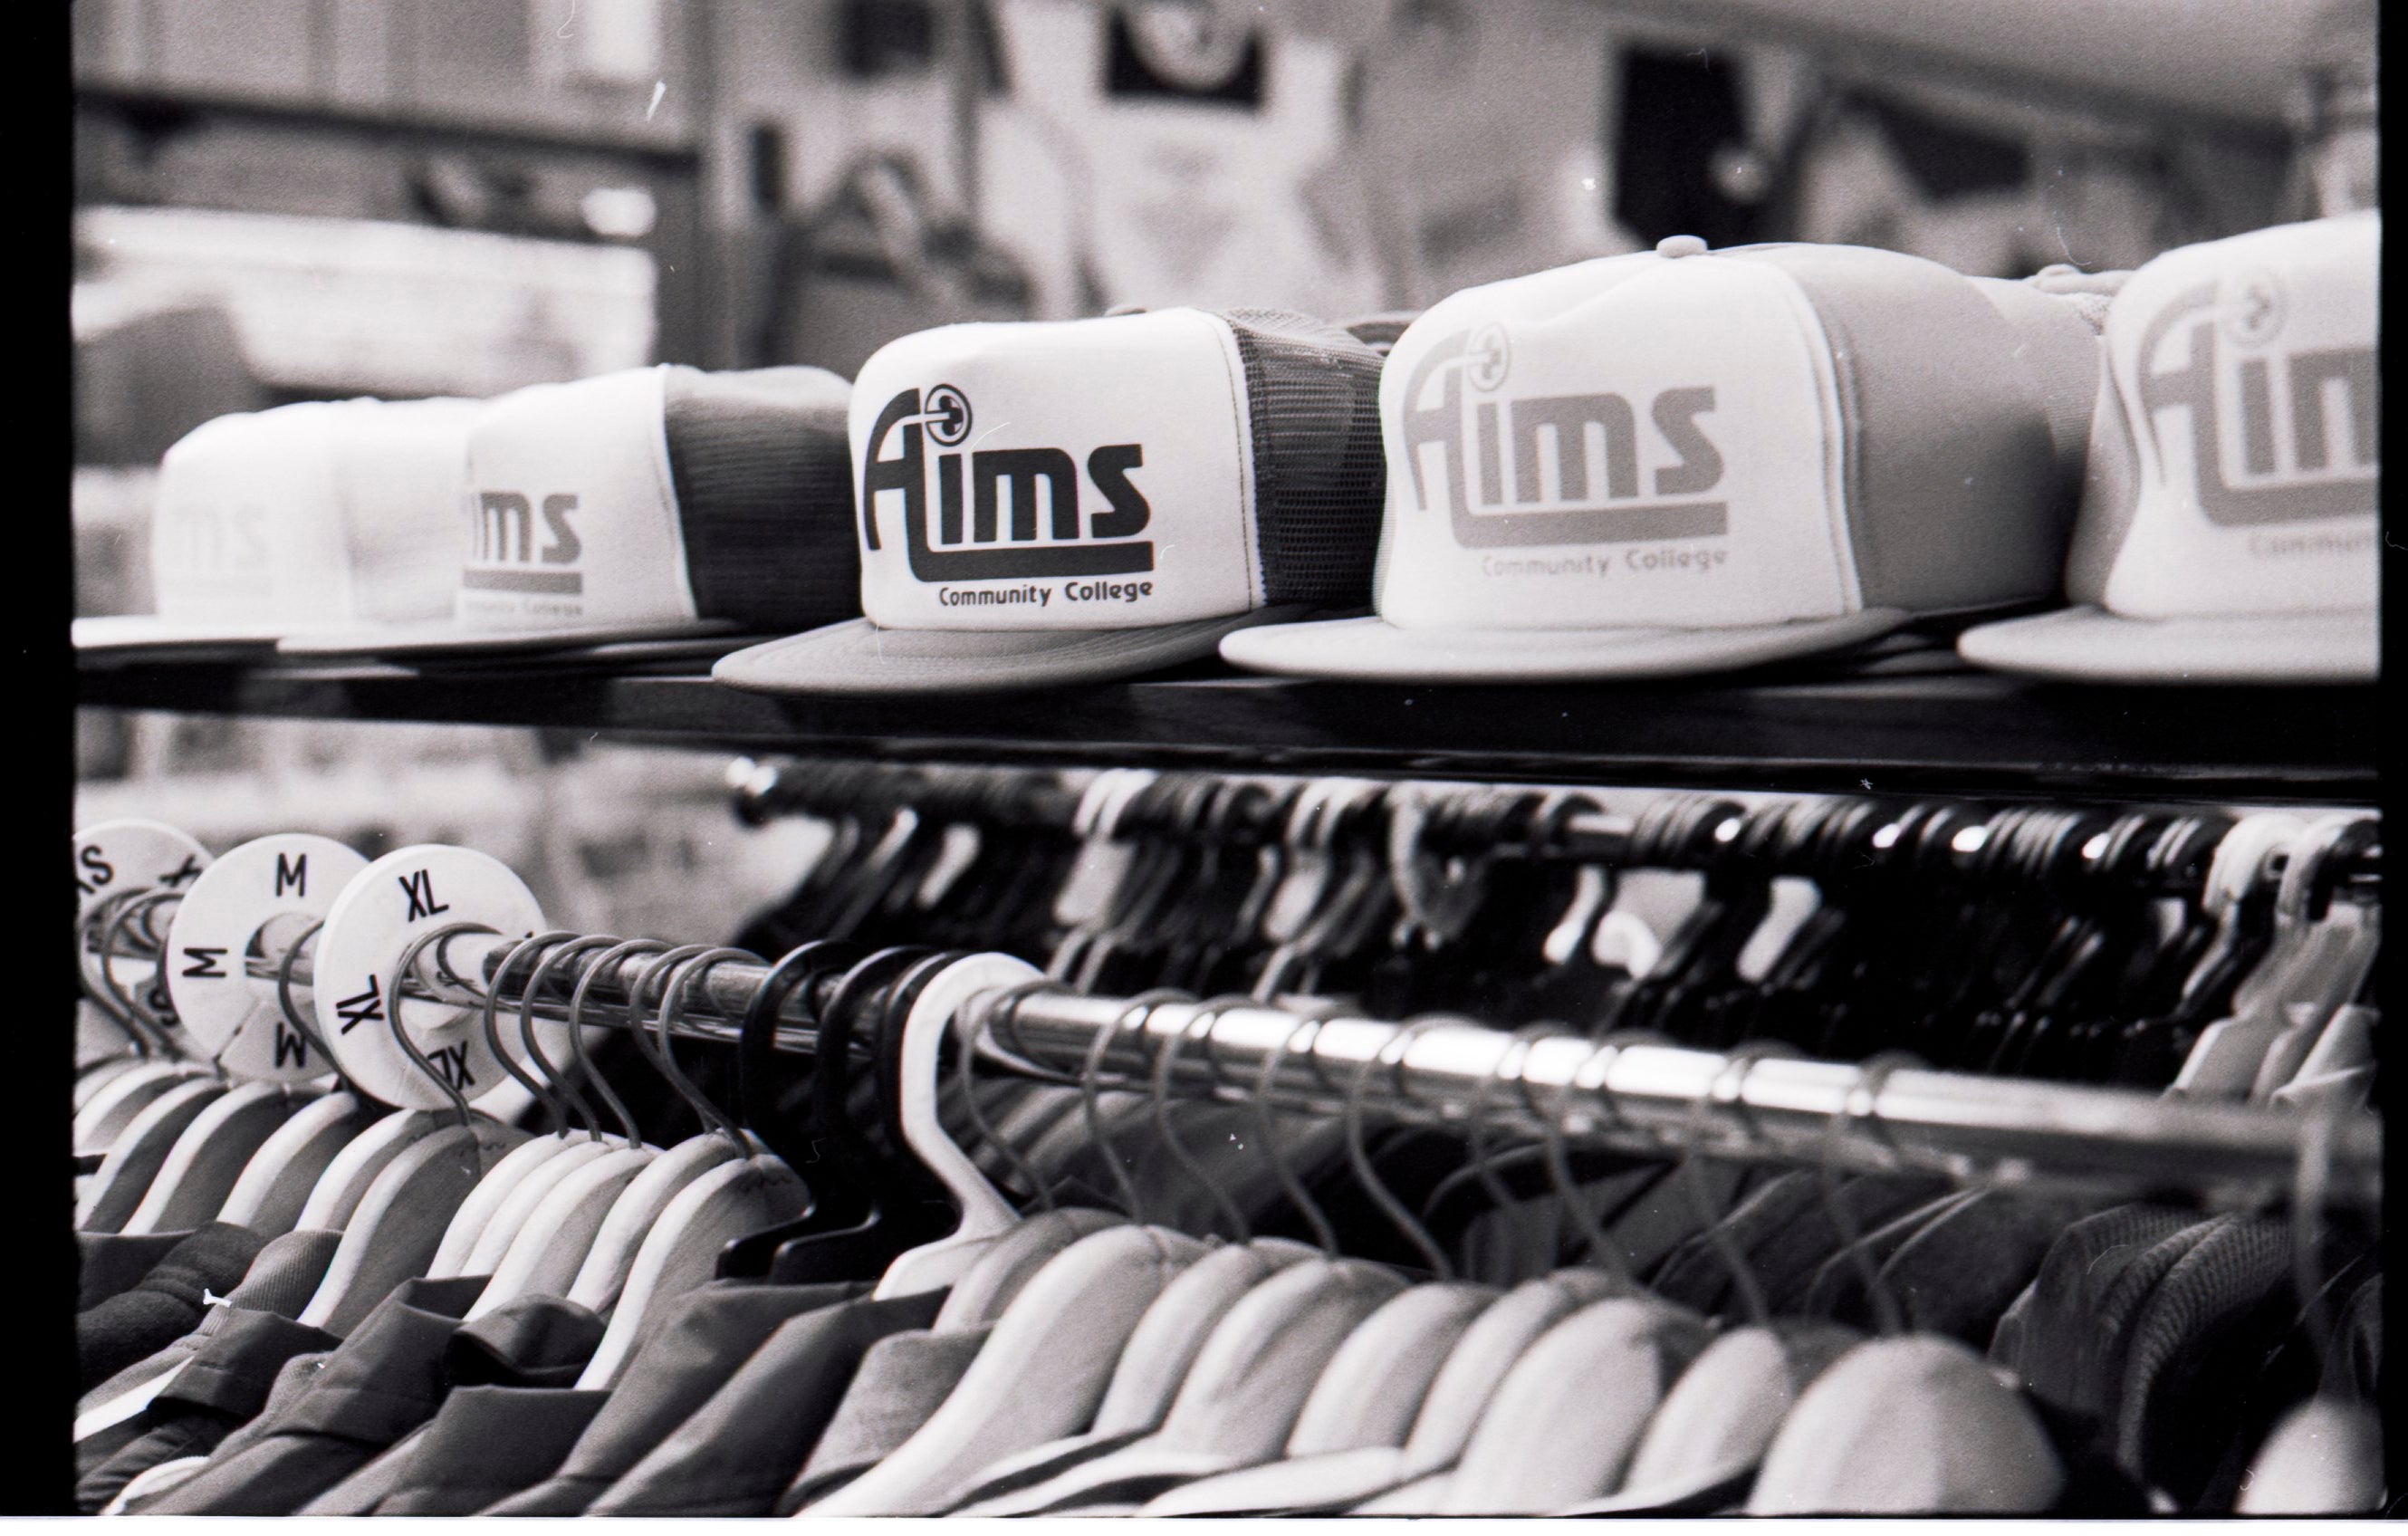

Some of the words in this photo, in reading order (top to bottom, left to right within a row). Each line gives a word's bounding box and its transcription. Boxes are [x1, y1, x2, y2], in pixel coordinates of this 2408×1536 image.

[2137, 270, 2379, 527] Aim
[1403, 324, 1728, 549] Aims
[863, 384, 1155, 582] Aims
[1482, 553, 1611, 578] Community
[1625, 547, 1729, 572] College
[939, 583, 1052, 607] Community
[1065, 581, 1153, 603] College
[275, 852, 307, 898] M
[398, 869, 449, 923] XL
[182, 947, 228, 978] M
[336, 974, 385, 1035] XL
[428, 1040, 476, 1090] XL
